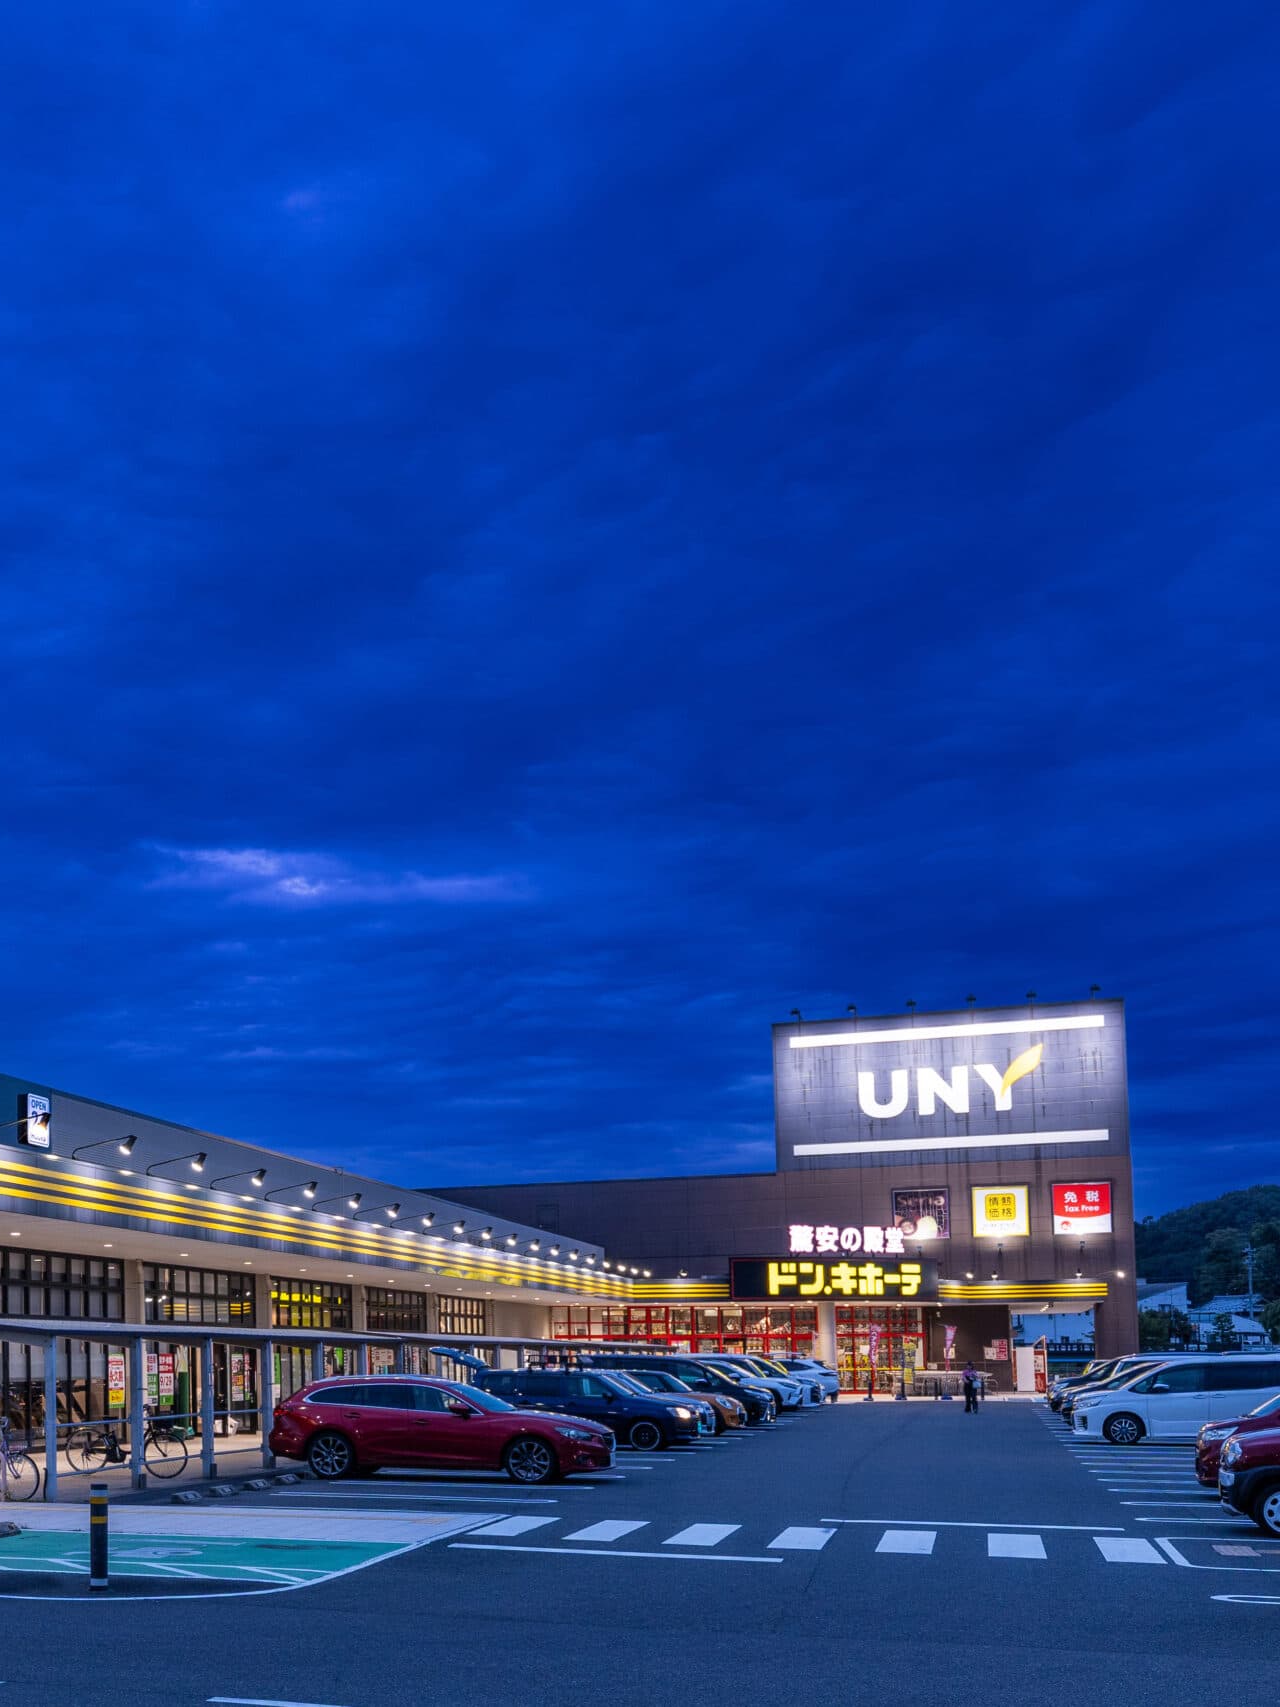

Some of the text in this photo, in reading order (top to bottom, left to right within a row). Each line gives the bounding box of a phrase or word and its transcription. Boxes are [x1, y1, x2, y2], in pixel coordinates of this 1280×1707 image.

[858, 1043, 1043, 1119] UNY
[31, 1099, 47, 1111] OPEN
[1081, 1204, 1100, 1212] Free
